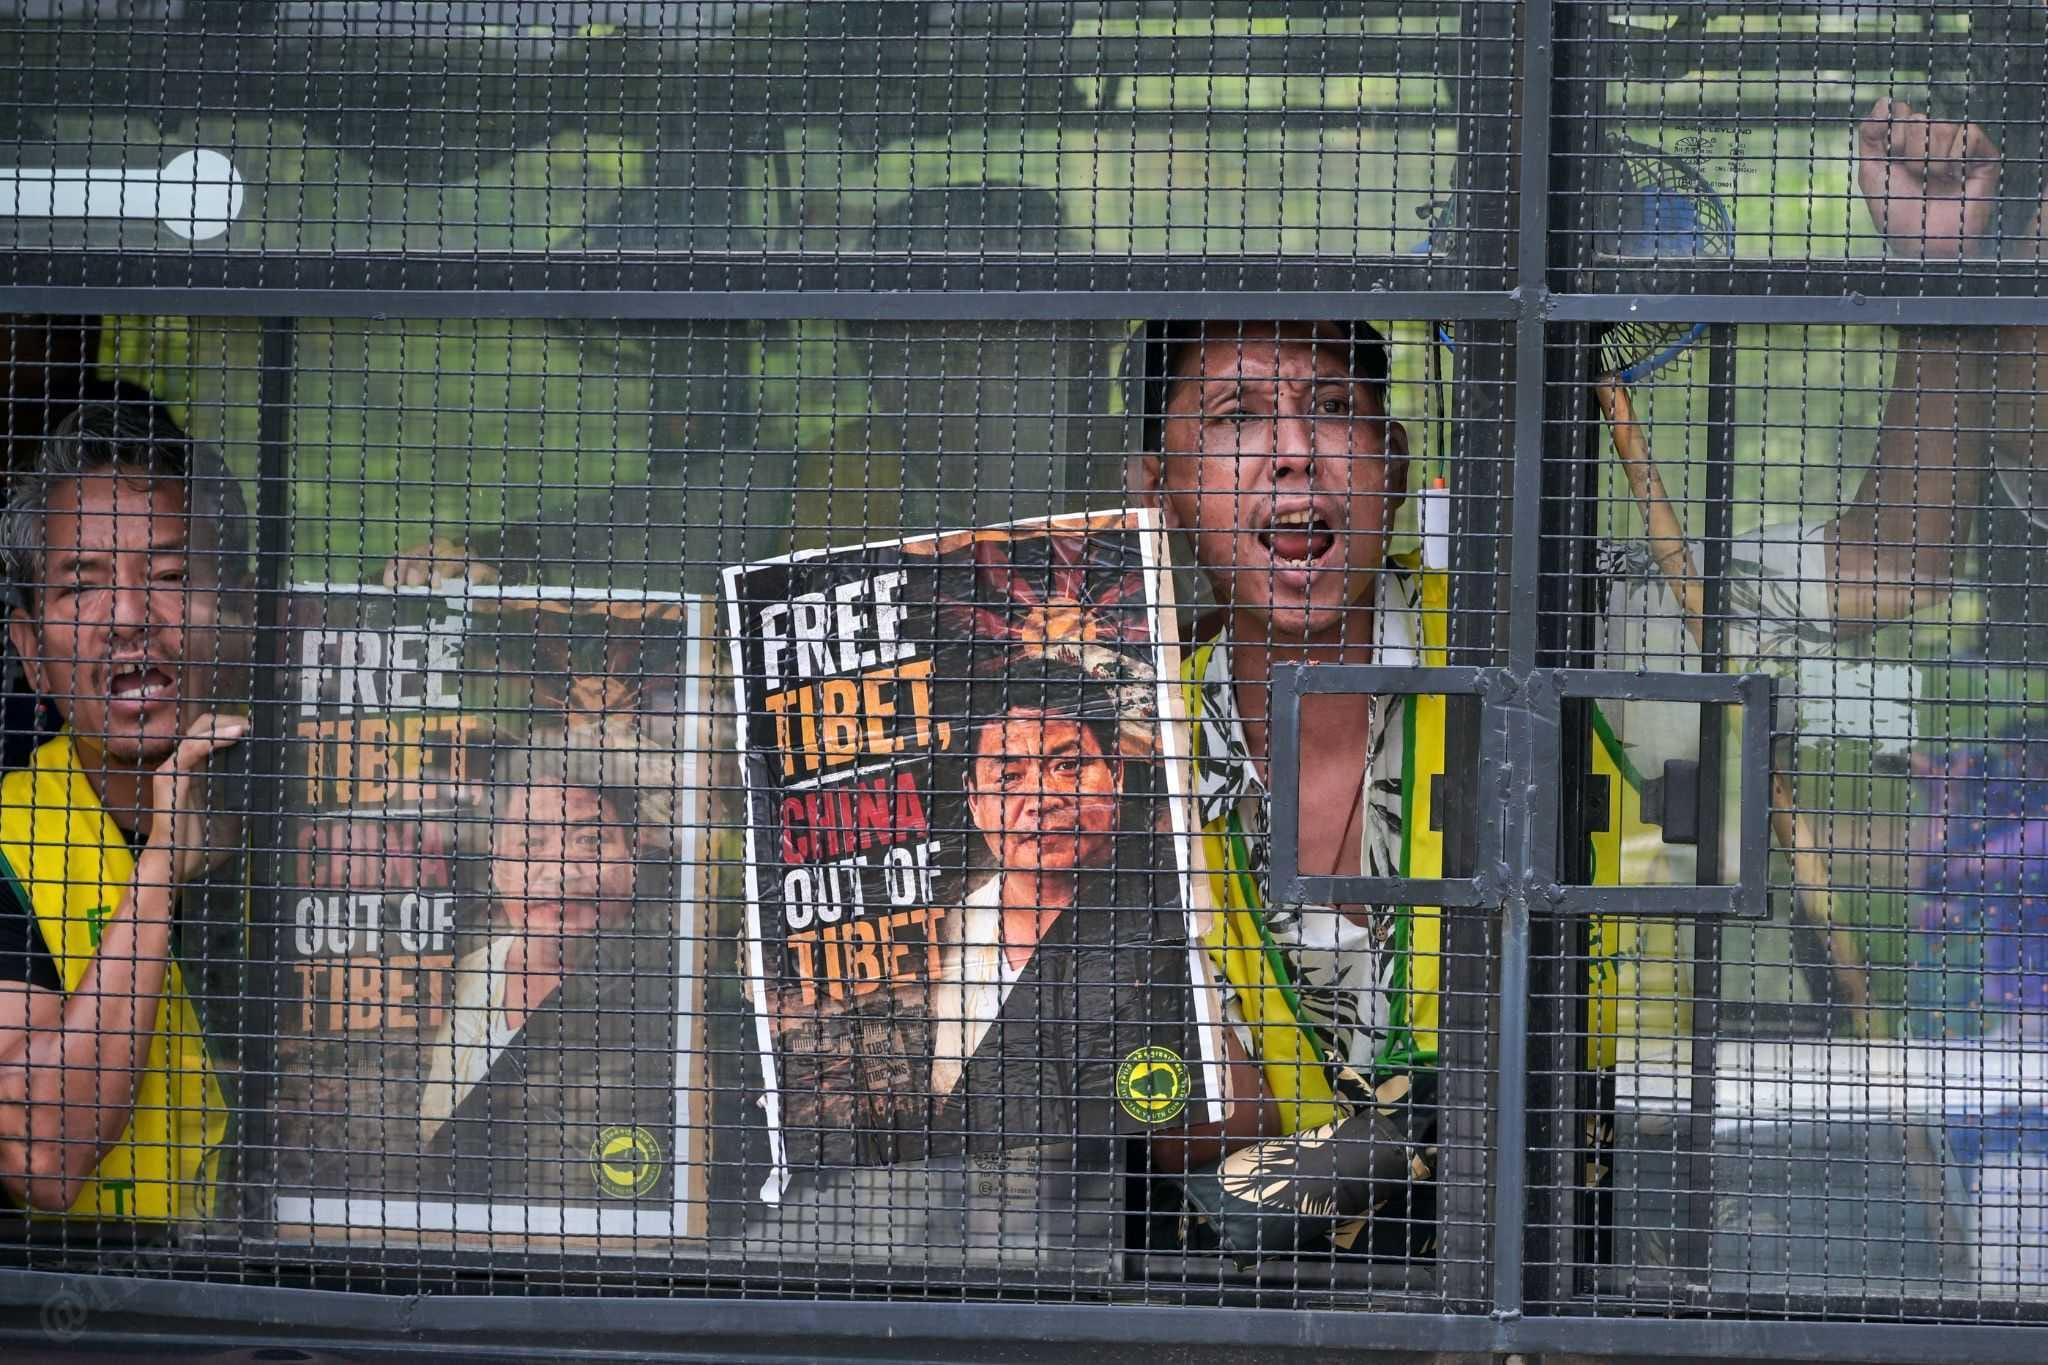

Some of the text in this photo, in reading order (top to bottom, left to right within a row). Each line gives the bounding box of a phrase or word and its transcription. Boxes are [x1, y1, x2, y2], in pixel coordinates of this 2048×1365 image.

[301, 615, 468, 717] FREE
[760, 570, 917, 690] FREE
[765, 659, 951, 777] TIBET,
[296, 821, 449, 889] CHINA
[782, 772, 928, 865] CHINA
[295, 892, 456, 955] OUT OF
[785, 841, 942, 930] OUT OF
[294, 954, 455, 1032] TIBET
[788, 908, 946, 1007] TIBET
